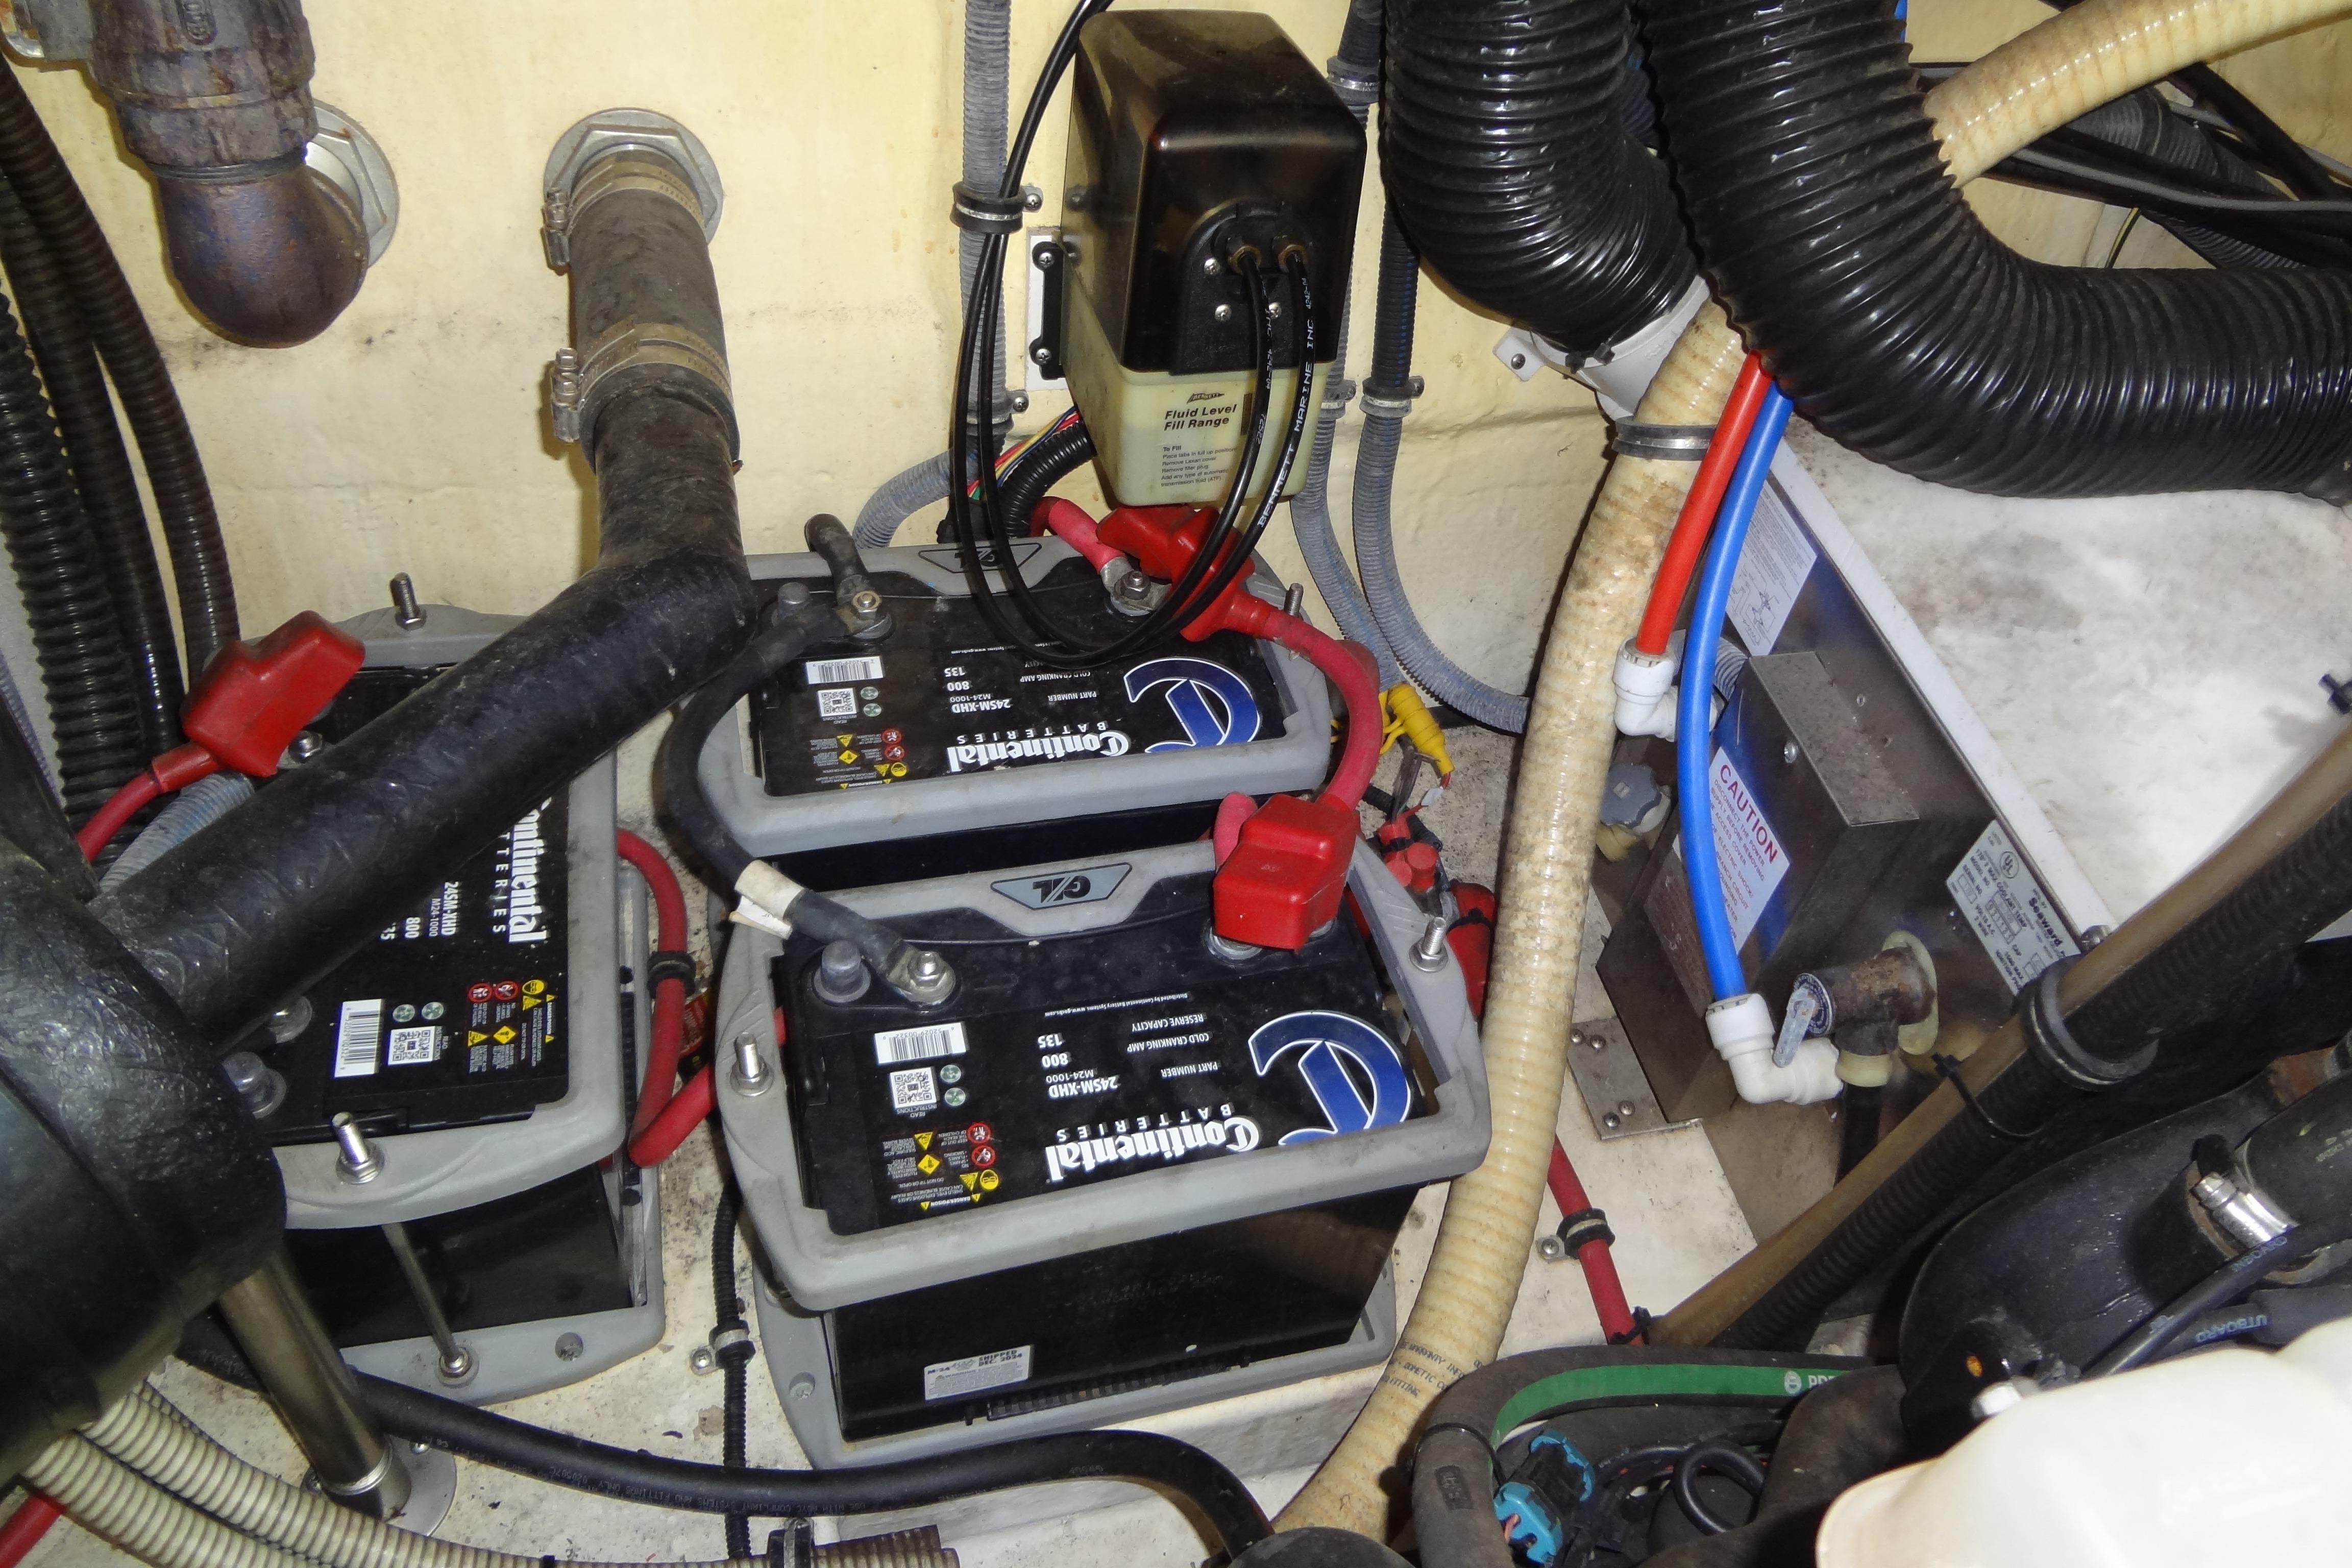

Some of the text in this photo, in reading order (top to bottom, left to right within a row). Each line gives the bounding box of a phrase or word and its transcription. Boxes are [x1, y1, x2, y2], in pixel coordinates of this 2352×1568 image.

[1293, 361, 1313, 432] MARINE
[1165, 404, 1237, 420] Fluid Level
[1164, 418, 1230, 431] Fill Range
[944, 667, 965, 677] 135
[947, 681, 970, 691] 800
[1047, 691, 1097, 702] PART NUMBER
[949, 693, 991, 702] M24-1000
[951, 699, 1011, 713] 24SM-XHD
[956, 721, 1107, 745] BATTERIES
[946, 731, 1129, 772] Continental
[1713, 779, 1766, 867] DISCONNECT THE POWER
[1719, 764, 1778, 864] CAUTION
[1710, 787, 1766, 881] SUPPLY BEFORE REMOVING
[1714, 812, 1747, 866] ACCESS COVER
[1717, 836, 1738, 869] ELECTRIC
[508, 797, 552, 943] ontinental
[492, 831, 510, 933] TTERIES
[1720, 871, 1738, 906] OUNDING
[1731, 881, 1749, 910] CIRCUIT
[1996, 881, 2015, 911] COOLANT
[429, 898, 441, 937] M24-1000
[440, 881, 459, 936] 24SM-XHD
[380, 922, 397, 940] 35
[404, 917, 421, 938] 800
[2027, 897, 2063, 947] Seaward
[1132, 1013, 1204, 1032] RESERVE CAPACITY
[1037, 1034, 1063, 1048] 135
[1126, 1033, 1210, 1052] COLD CRANKING AMP
[1041, 1052, 1069, 1068] 800
[1160, 1062, 1218, 1078] PART NUMBER
[1046, 1069, 1094, 1083] M24-1000
[1048, 1075, 1118, 1098] 24SM-XHD
[896, 1104, 937, 1114] INSTRUCTIONS
[1056, 1104, 1233, 1142] BATTERIES
[1045, 1117, 1259, 1183] Continental
[2195, 1314, 2268, 1343] UTBOARD
[979, 1350, 1017, 1362] SHIPPED
[1001, 1353, 1023, 1362] 2024
[599, 1480, 620, 1492] ONLY
[625, 1486, 670, 1500] FITTINGS
[697, 1498, 734, 1510] SYSTEMS
